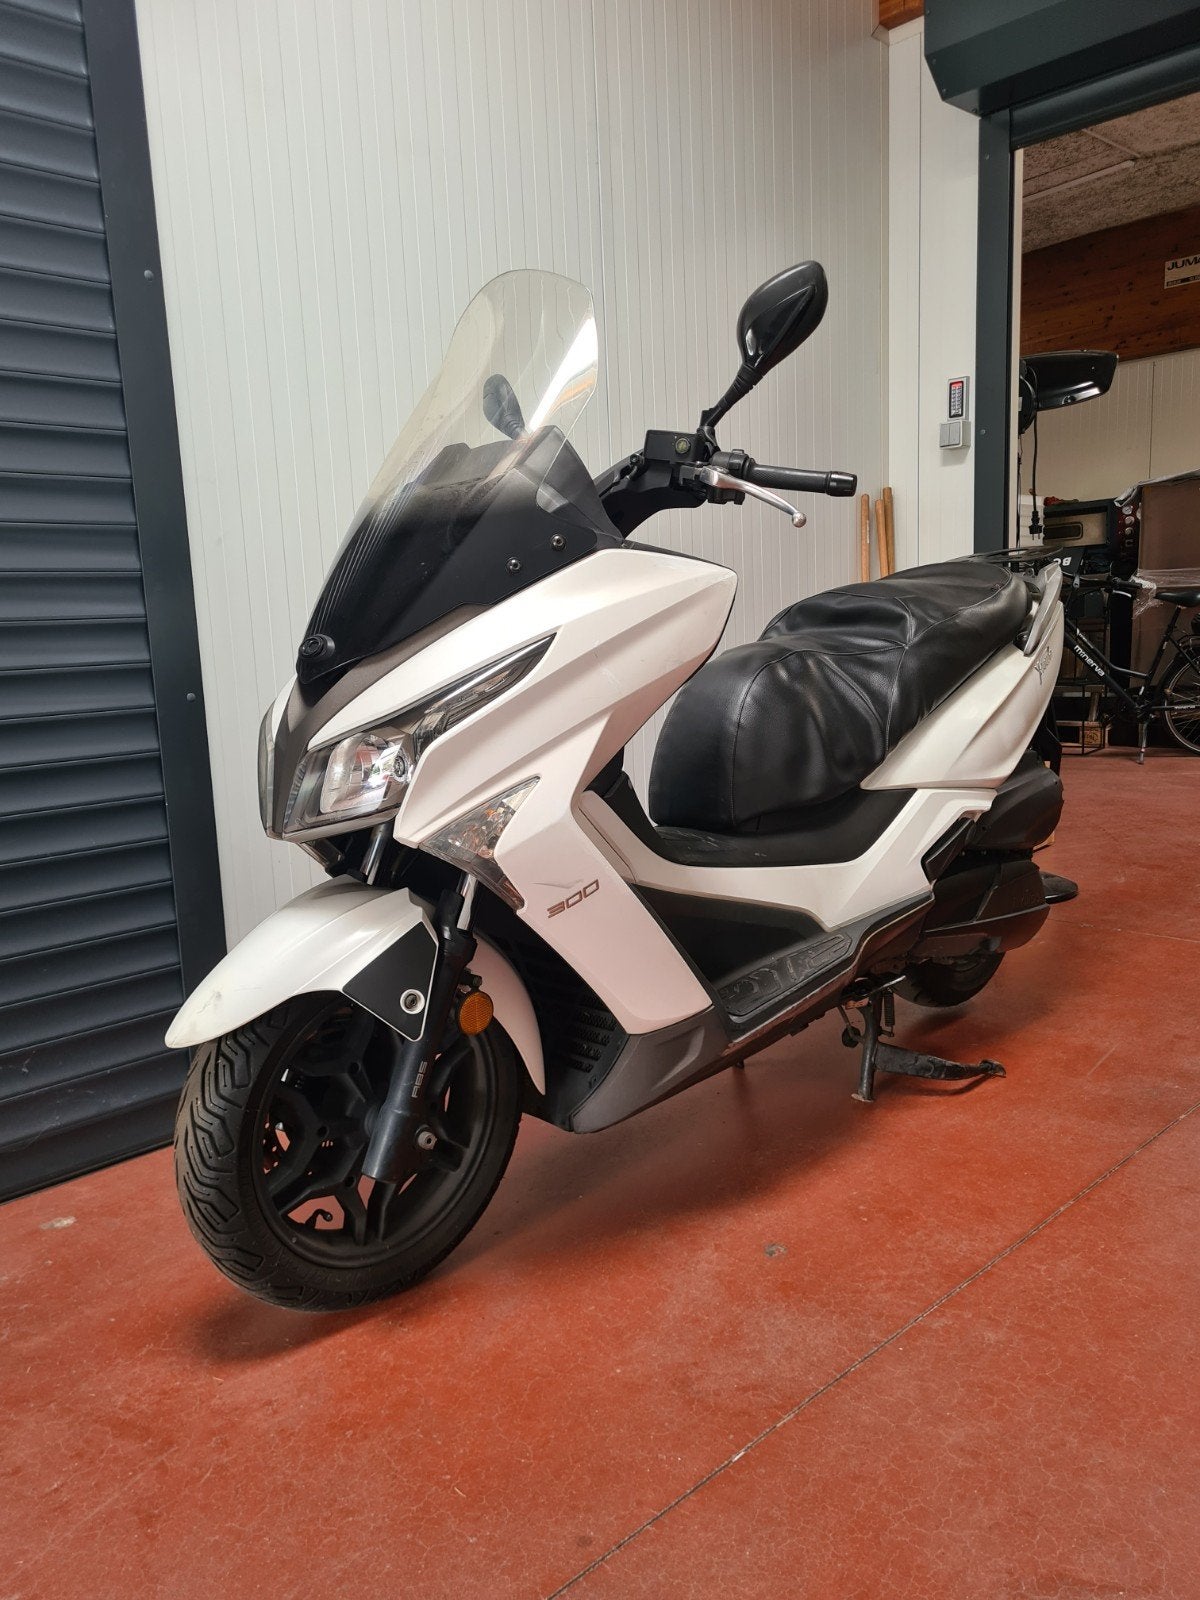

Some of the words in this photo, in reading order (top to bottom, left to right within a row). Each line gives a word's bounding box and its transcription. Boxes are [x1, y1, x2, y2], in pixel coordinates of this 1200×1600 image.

[1073, 645, 1105, 677] minerva
[547, 879, 599, 918] 300
[411, 1061, 428, 1098] ABS
